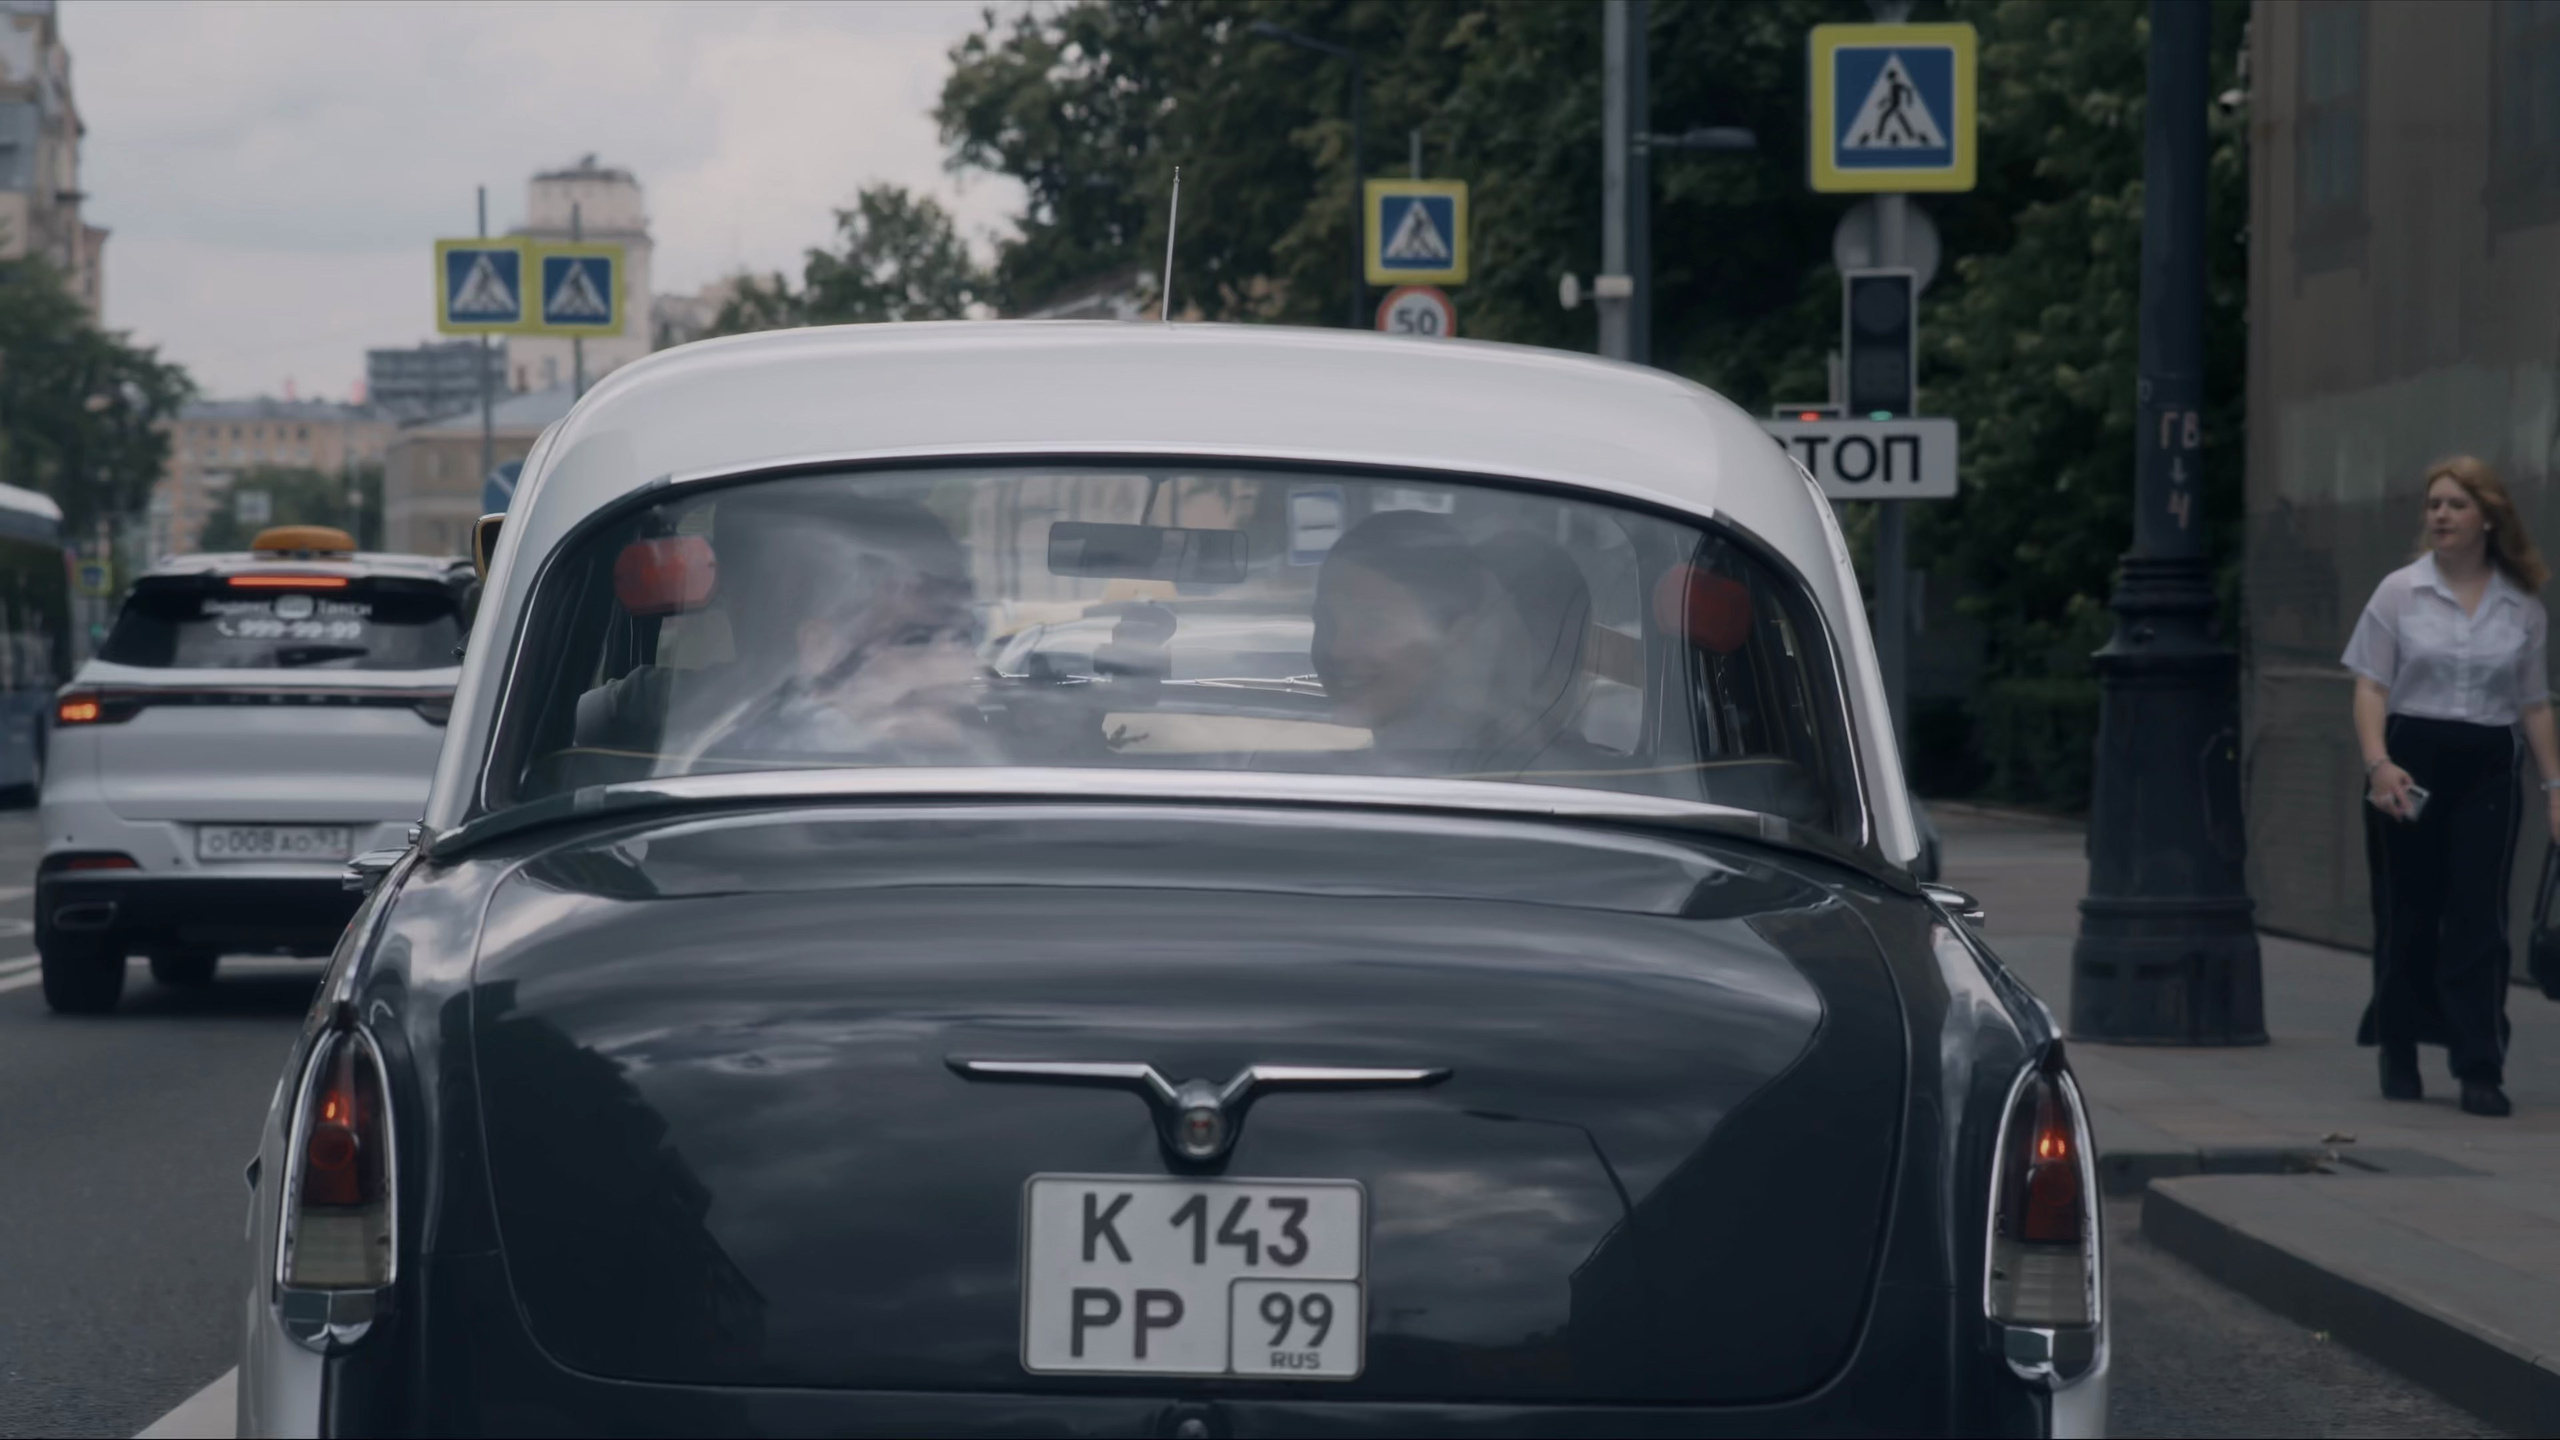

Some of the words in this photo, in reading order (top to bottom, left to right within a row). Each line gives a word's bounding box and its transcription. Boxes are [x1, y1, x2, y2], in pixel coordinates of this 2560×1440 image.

[1396, 307, 1438, 334] 50
[1772, 435, 1921, 482] ТОП
[1169, 1193, 1309, 1266] 143
[1259, 1292, 1334, 1348] 99
[1270, 1352, 1321, 1369] RUS
